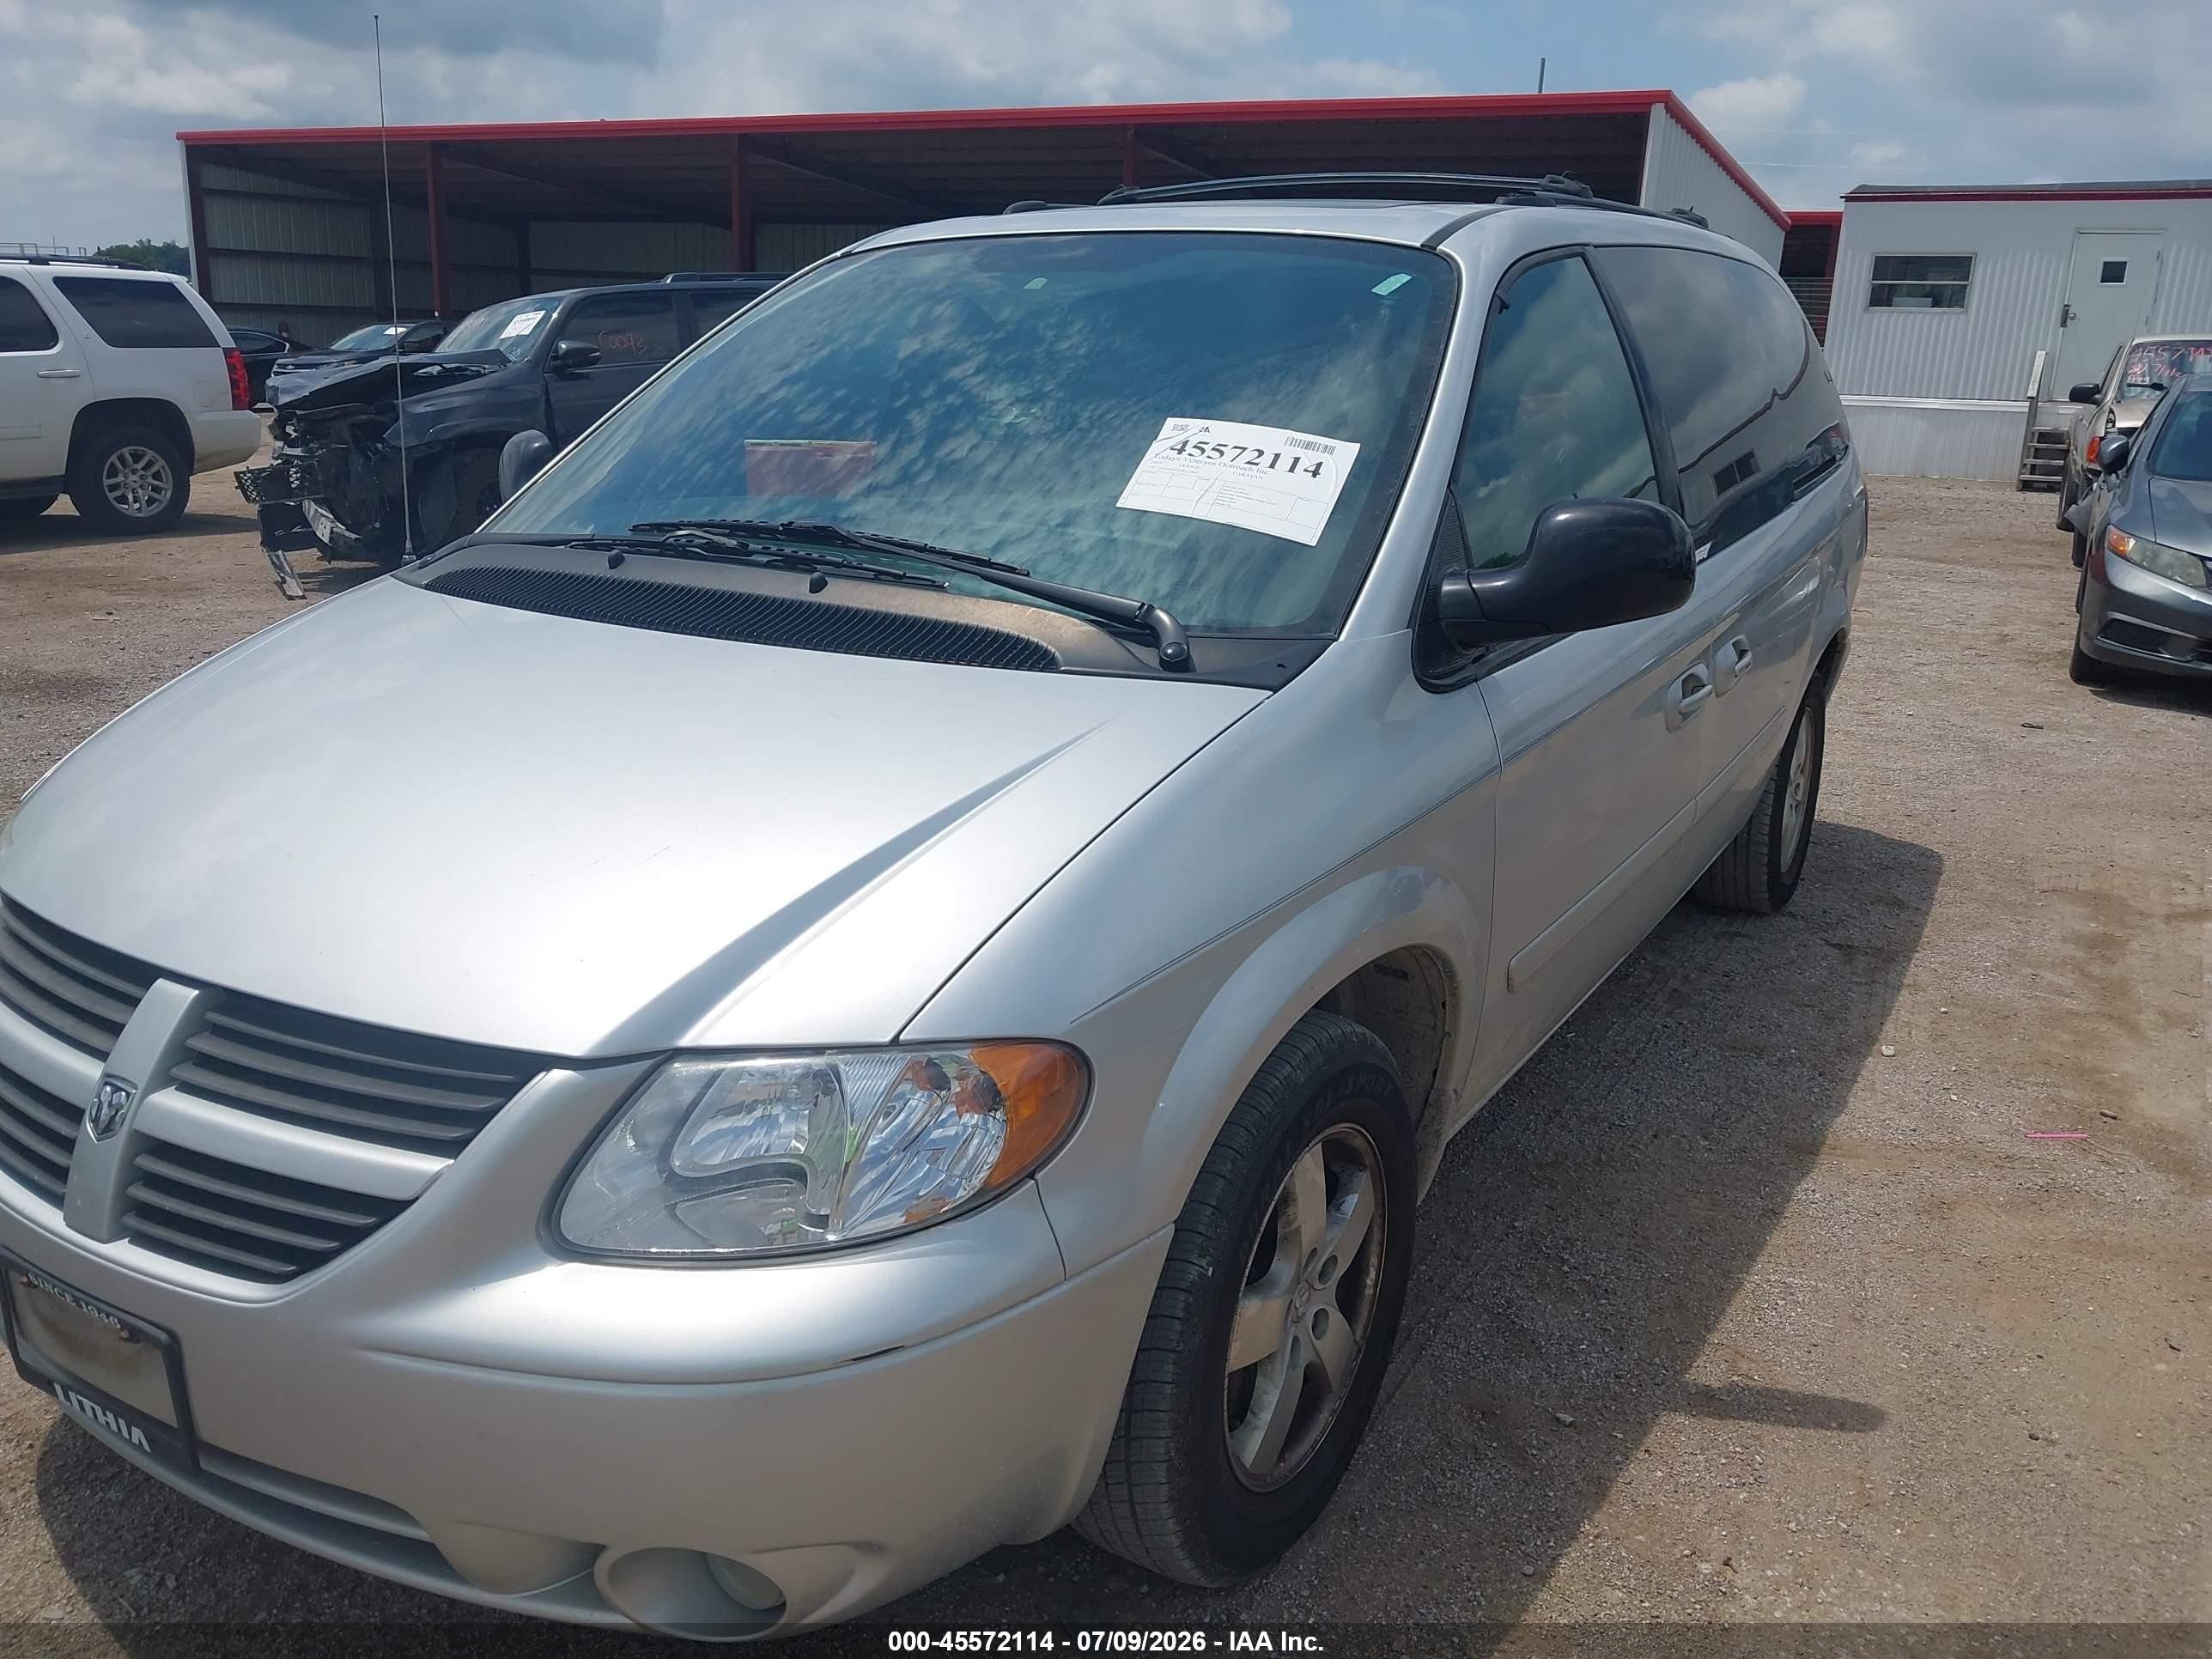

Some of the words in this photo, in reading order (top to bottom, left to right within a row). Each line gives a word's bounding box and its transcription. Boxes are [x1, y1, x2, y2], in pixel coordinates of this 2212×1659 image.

[1154, 453, 1180, 462] Todays
[1184, 456, 1216, 466] Veterans
[1218, 462, 1254, 472] Outreach
[1169, 439, 1324, 478] 45572114
[27, 1273, 76, 1306] SINCE
[53, 1381, 152, 1453] LITHIA
